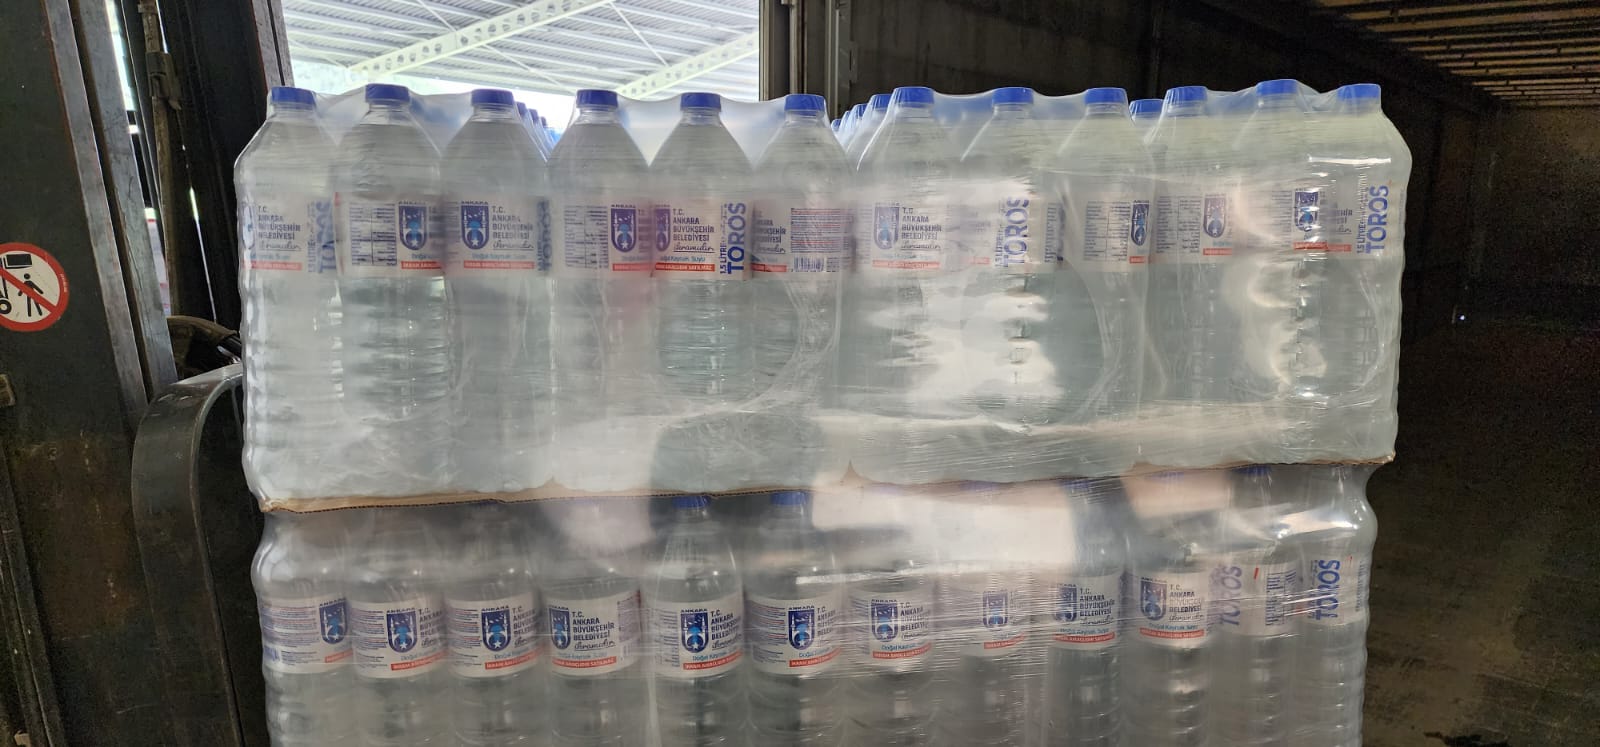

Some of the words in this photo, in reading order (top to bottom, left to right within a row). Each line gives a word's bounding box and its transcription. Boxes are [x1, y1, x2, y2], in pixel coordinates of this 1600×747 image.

[673, 217, 700, 225] ANKARA
[1365, 185, 1389, 254] TOROS
[673, 225, 715, 234] BÜYÜKŞEHİR
[1004, 196, 1029, 268] TOROS
[673, 233, 710, 242] BELEDİYESİ
[727, 202, 746, 275] TOROS
[573, 617, 600, 625] ANKARA
[573, 621, 615, 634] BÜYÜKŞEHİR
[573, 630, 610, 641] BELEDİYESİ
